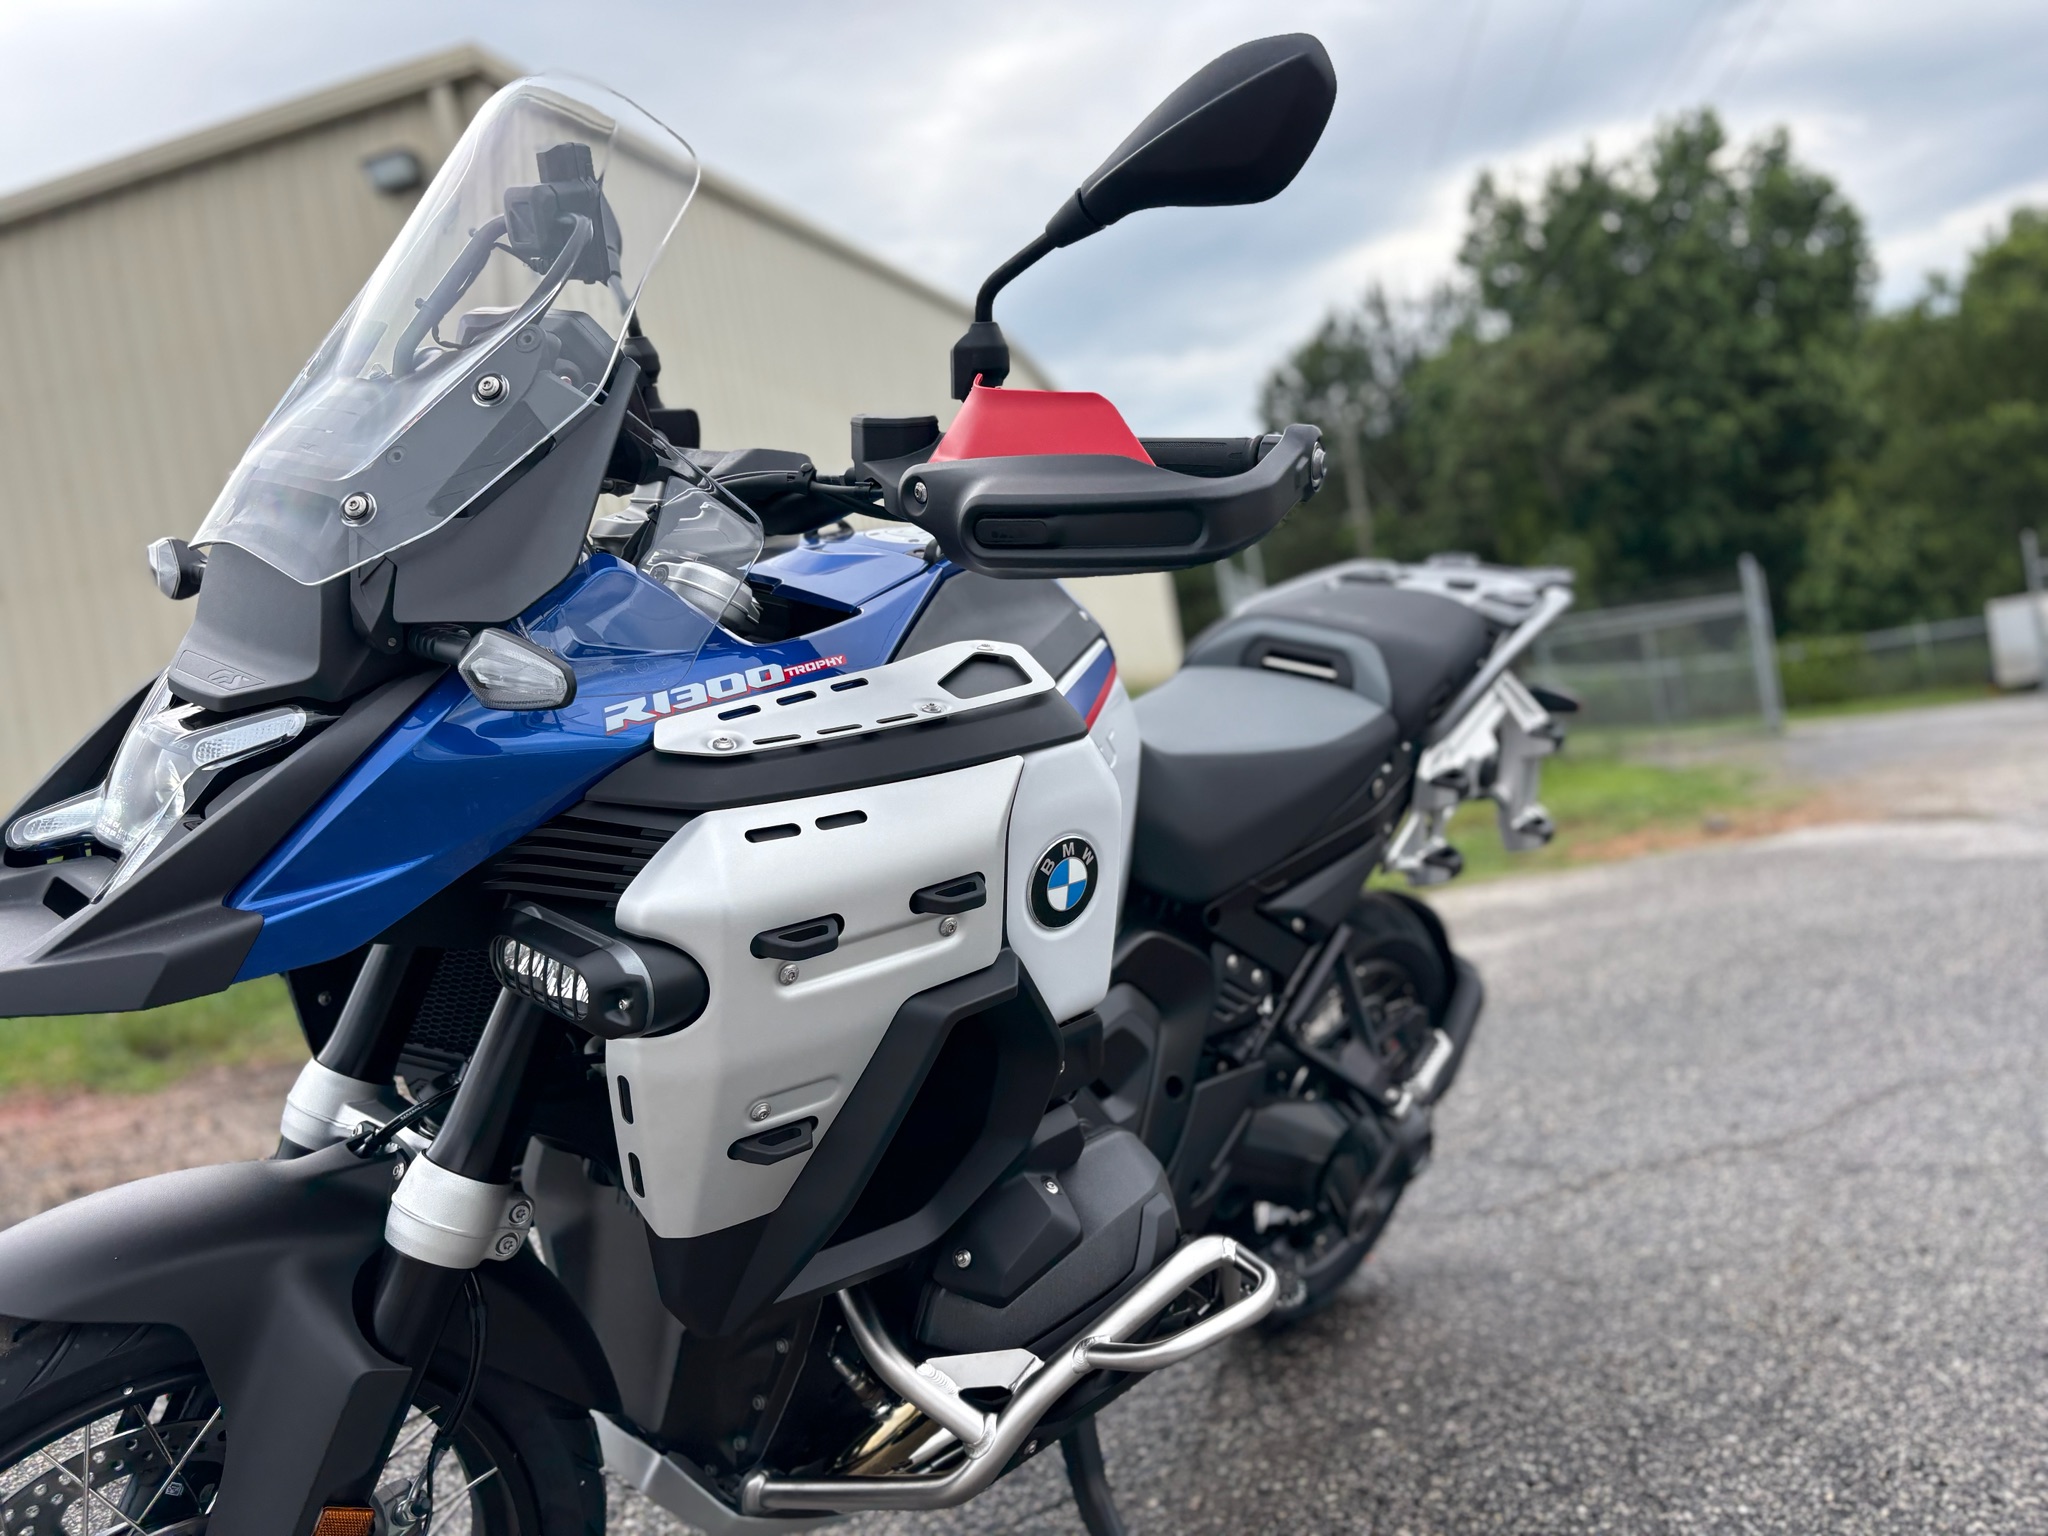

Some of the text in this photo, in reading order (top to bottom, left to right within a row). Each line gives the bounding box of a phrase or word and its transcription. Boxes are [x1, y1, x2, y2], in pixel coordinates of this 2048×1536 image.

[604, 663, 786, 734] R1300
[783, 655, 844, 677] TROPHY
[1040, 842, 1094, 876] BMW
